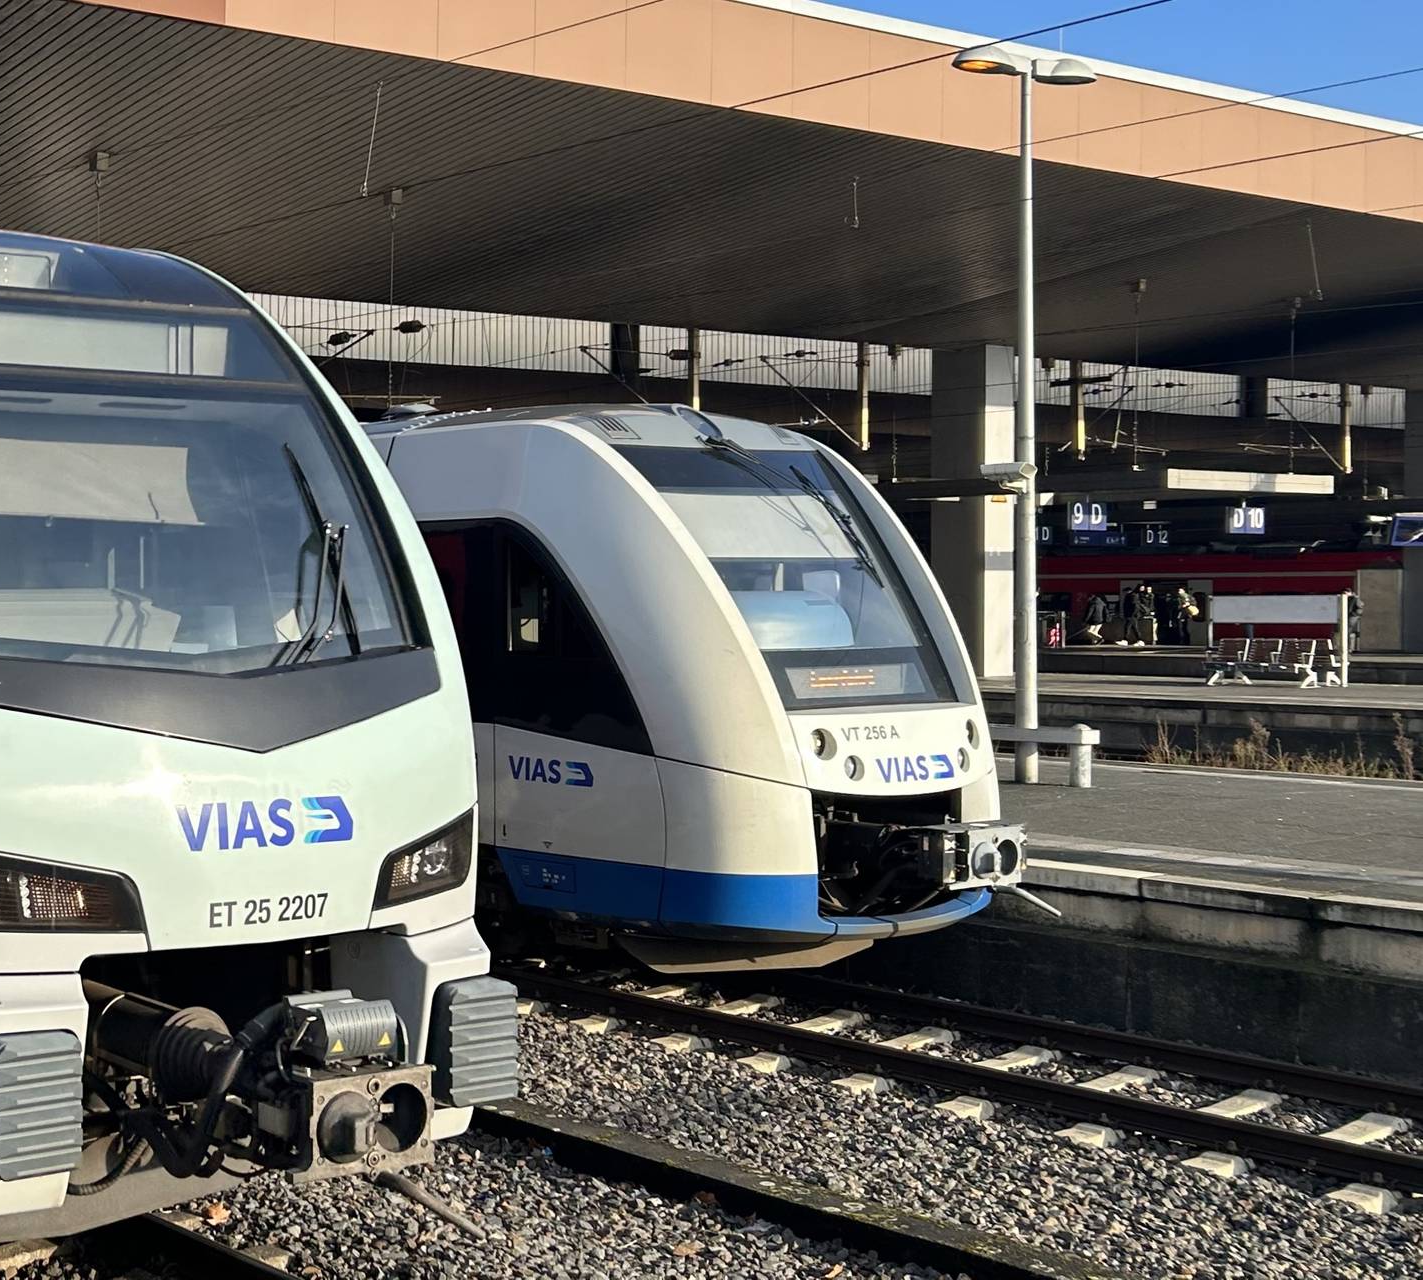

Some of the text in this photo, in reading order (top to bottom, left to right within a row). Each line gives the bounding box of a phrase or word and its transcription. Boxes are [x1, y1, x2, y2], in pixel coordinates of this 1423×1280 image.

[1073, 503, 1102, 524] 9 D
[1233, 508, 1264, 528] D 10
[1041, 526, 1050, 541] D
[1146, 530, 1168, 543] D 12
[841, 725, 901, 741] VT 256 A
[508, 755, 562, 785] VIAS
[875, 755, 930, 783] VIAS
[176, 797, 296, 852] VIAS
[209, 892, 329, 928] ET 25 2207
